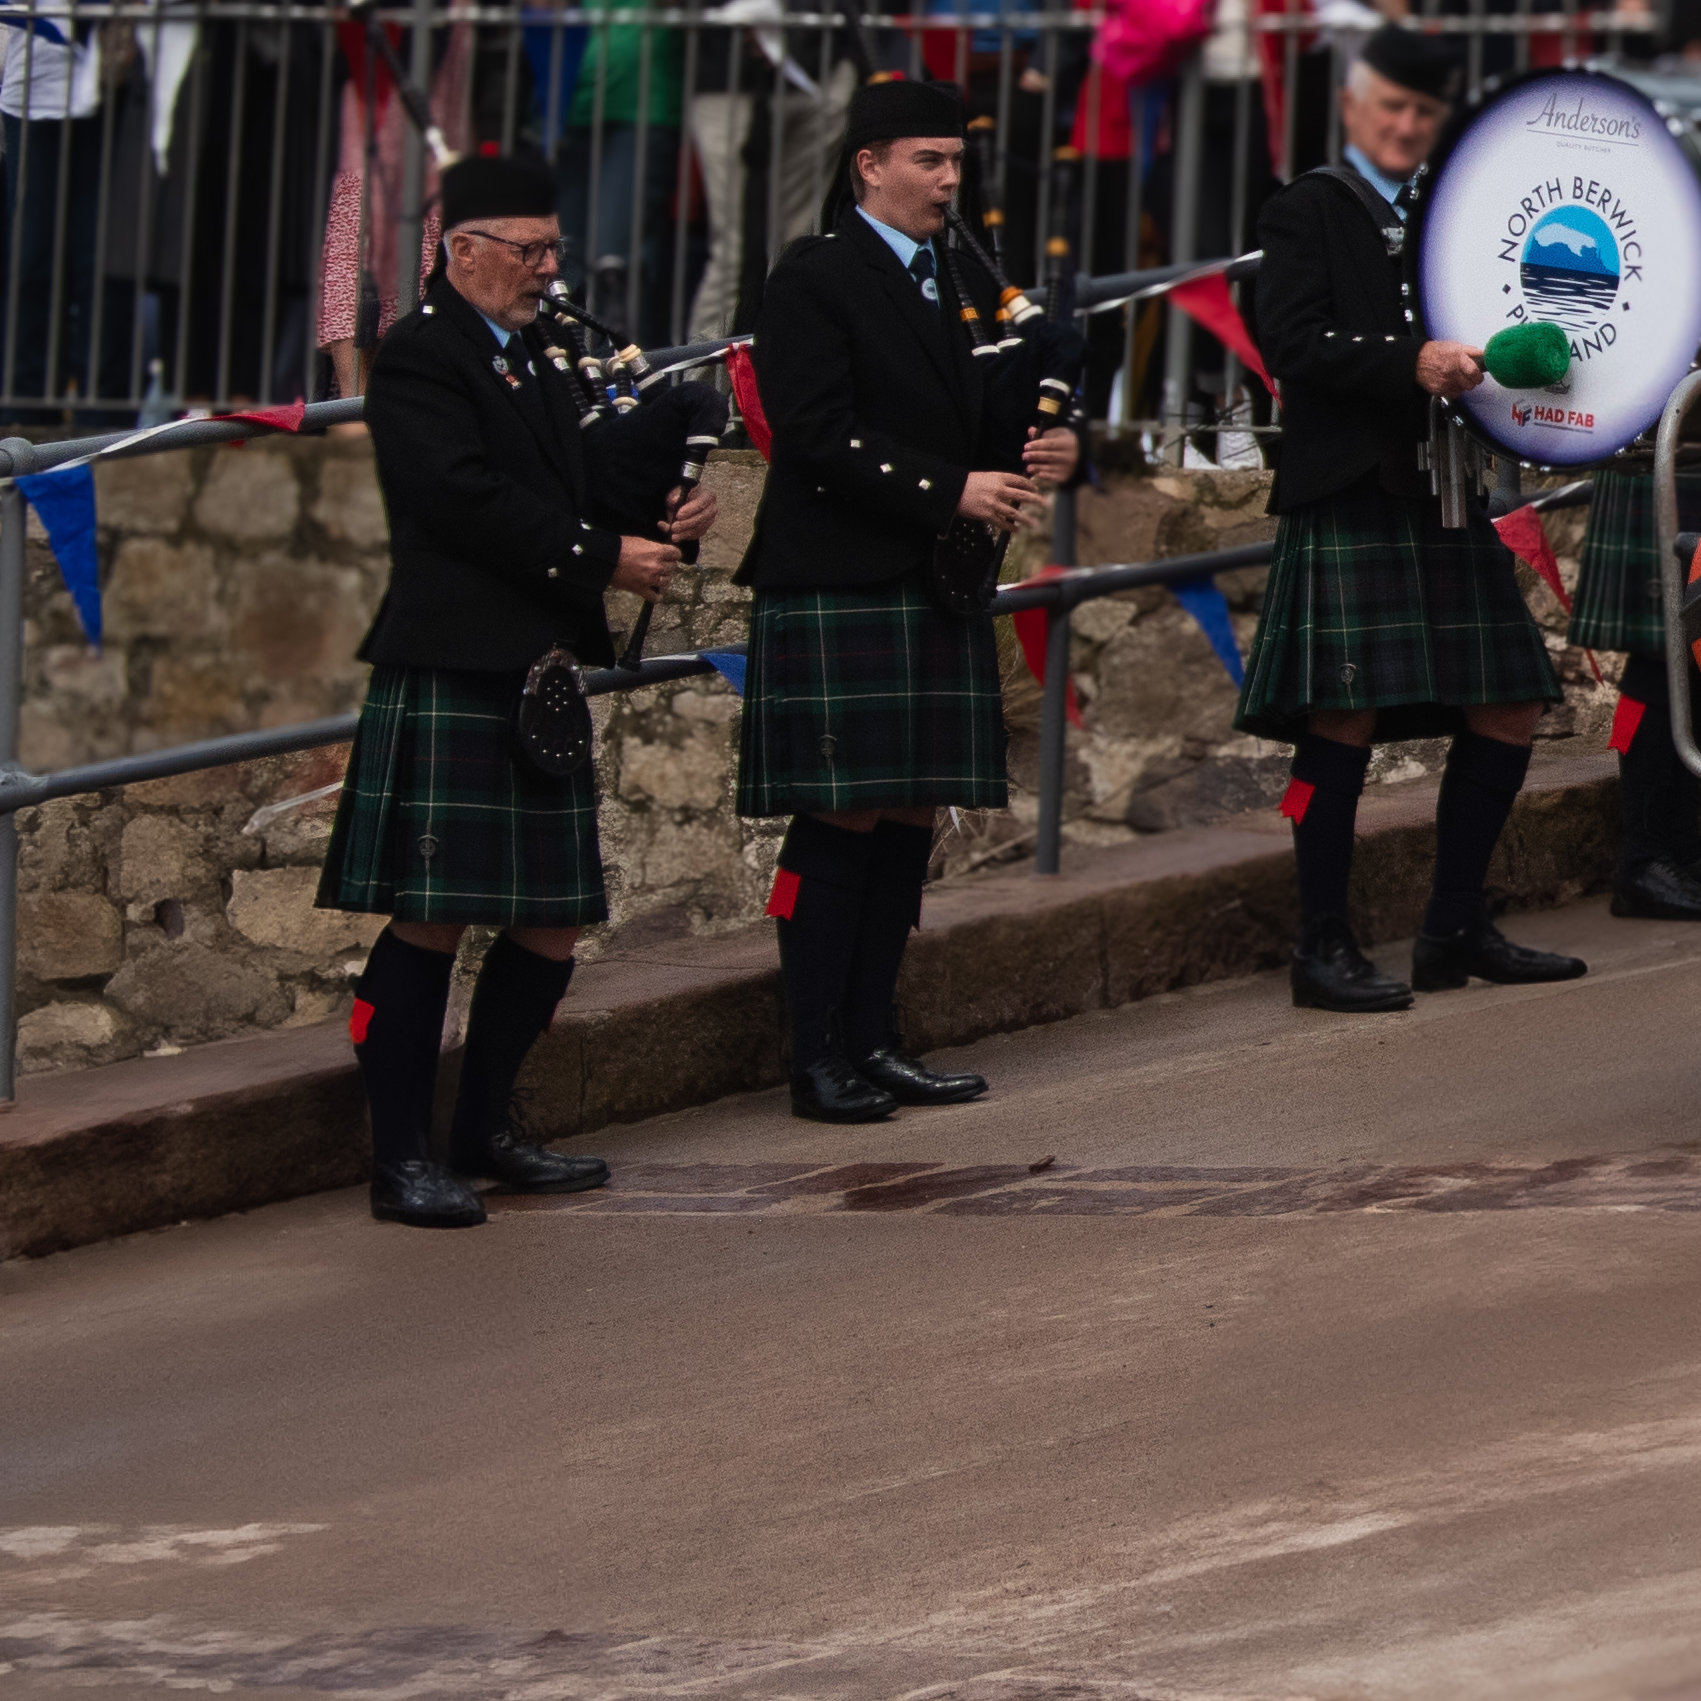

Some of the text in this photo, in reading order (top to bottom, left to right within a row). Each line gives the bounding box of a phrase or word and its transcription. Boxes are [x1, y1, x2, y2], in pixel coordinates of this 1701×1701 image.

[1526, 92, 1641, 139] Anderson's
[1497, 175, 1644, 283] NORTH BERWICK
[1569, 322, 1618, 363] AND
[1534, 405, 1565, 424] HAD
[1567, 411, 1595, 429] FAB
